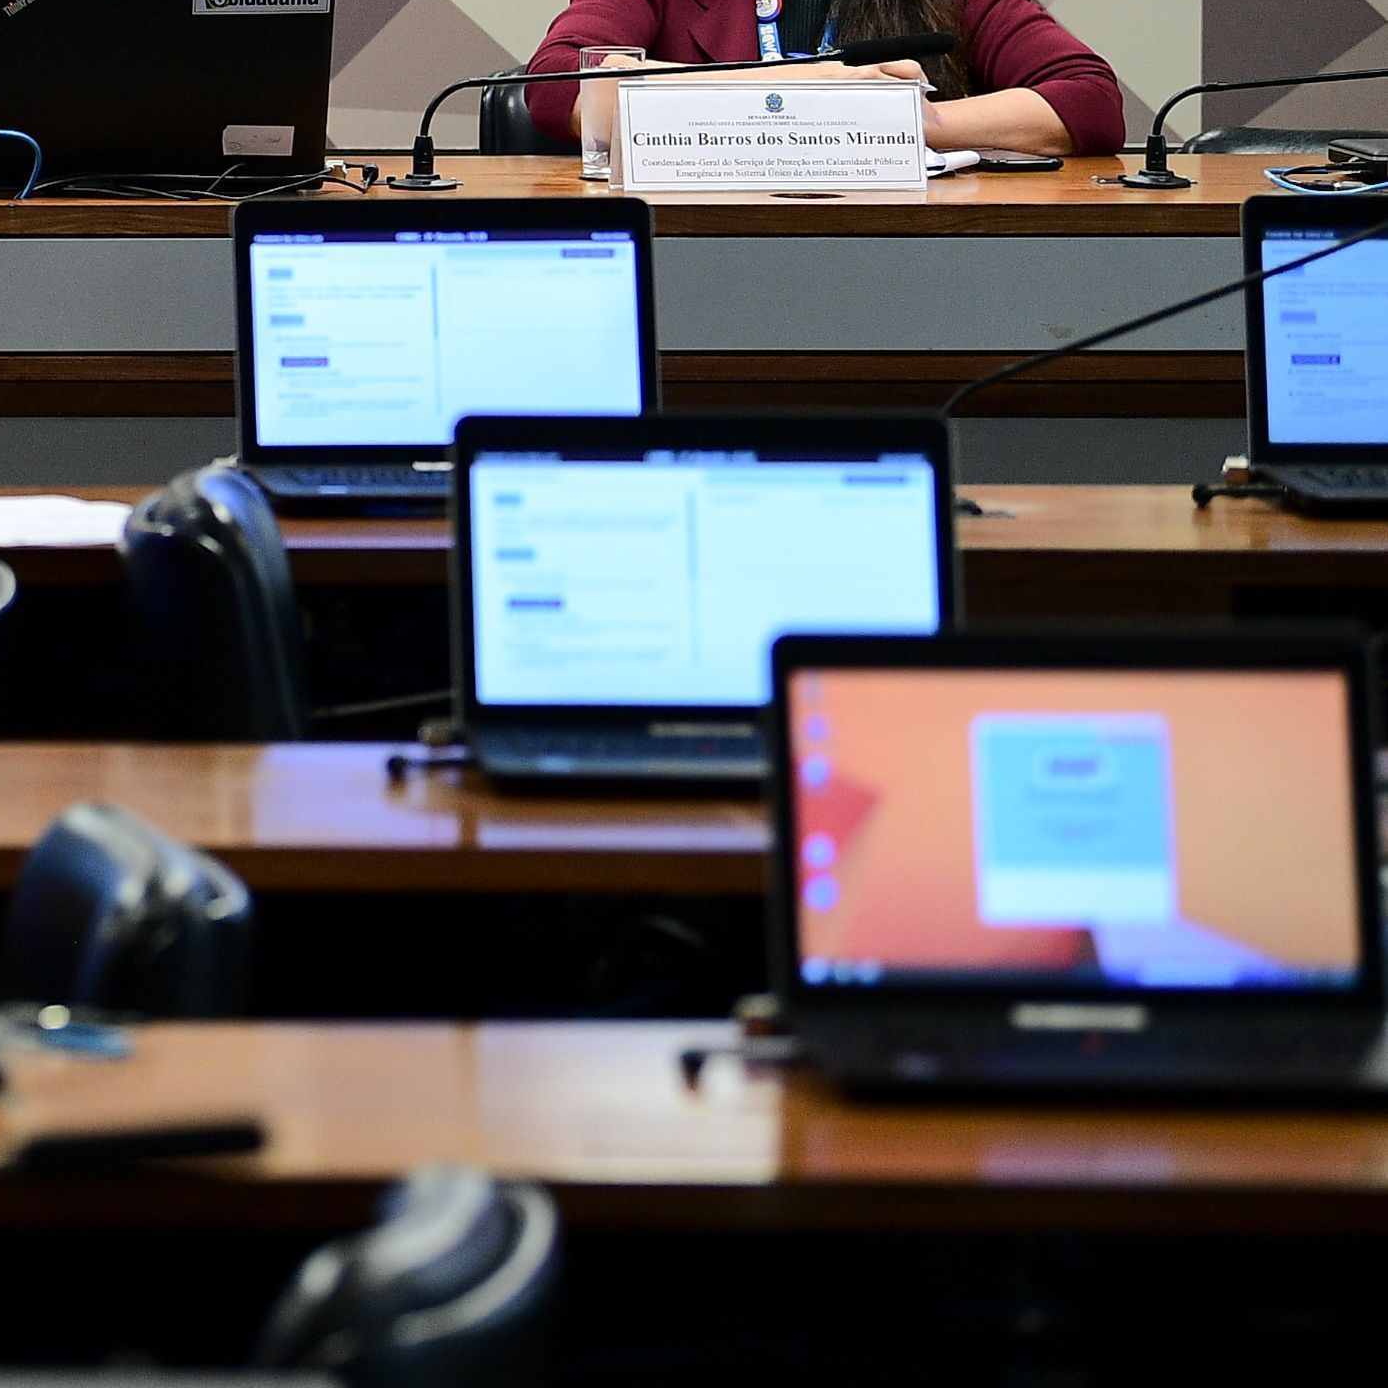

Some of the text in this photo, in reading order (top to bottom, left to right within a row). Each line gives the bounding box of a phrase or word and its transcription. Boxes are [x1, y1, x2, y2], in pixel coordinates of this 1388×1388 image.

[632, 131, 916, 147] Cinthia Barros dos Santos Miranda
[641, 158, 721, 167] Coordenadora-Geral
[721, 158, 733, 167] do
[733, 156, 764, 168] Serviço
[764, 158, 776, 167] de
[776, 157, 811, 168] Proteção
[825, 157, 874, 167] Calamidade
[675, 169, 722, 179] Emergência
[735, 169, 767, 177] Sistema
[792, 168, 803, 177] de
[804, 168, 849, 177] Assistência
[855, 168, 878, 177] MDS
